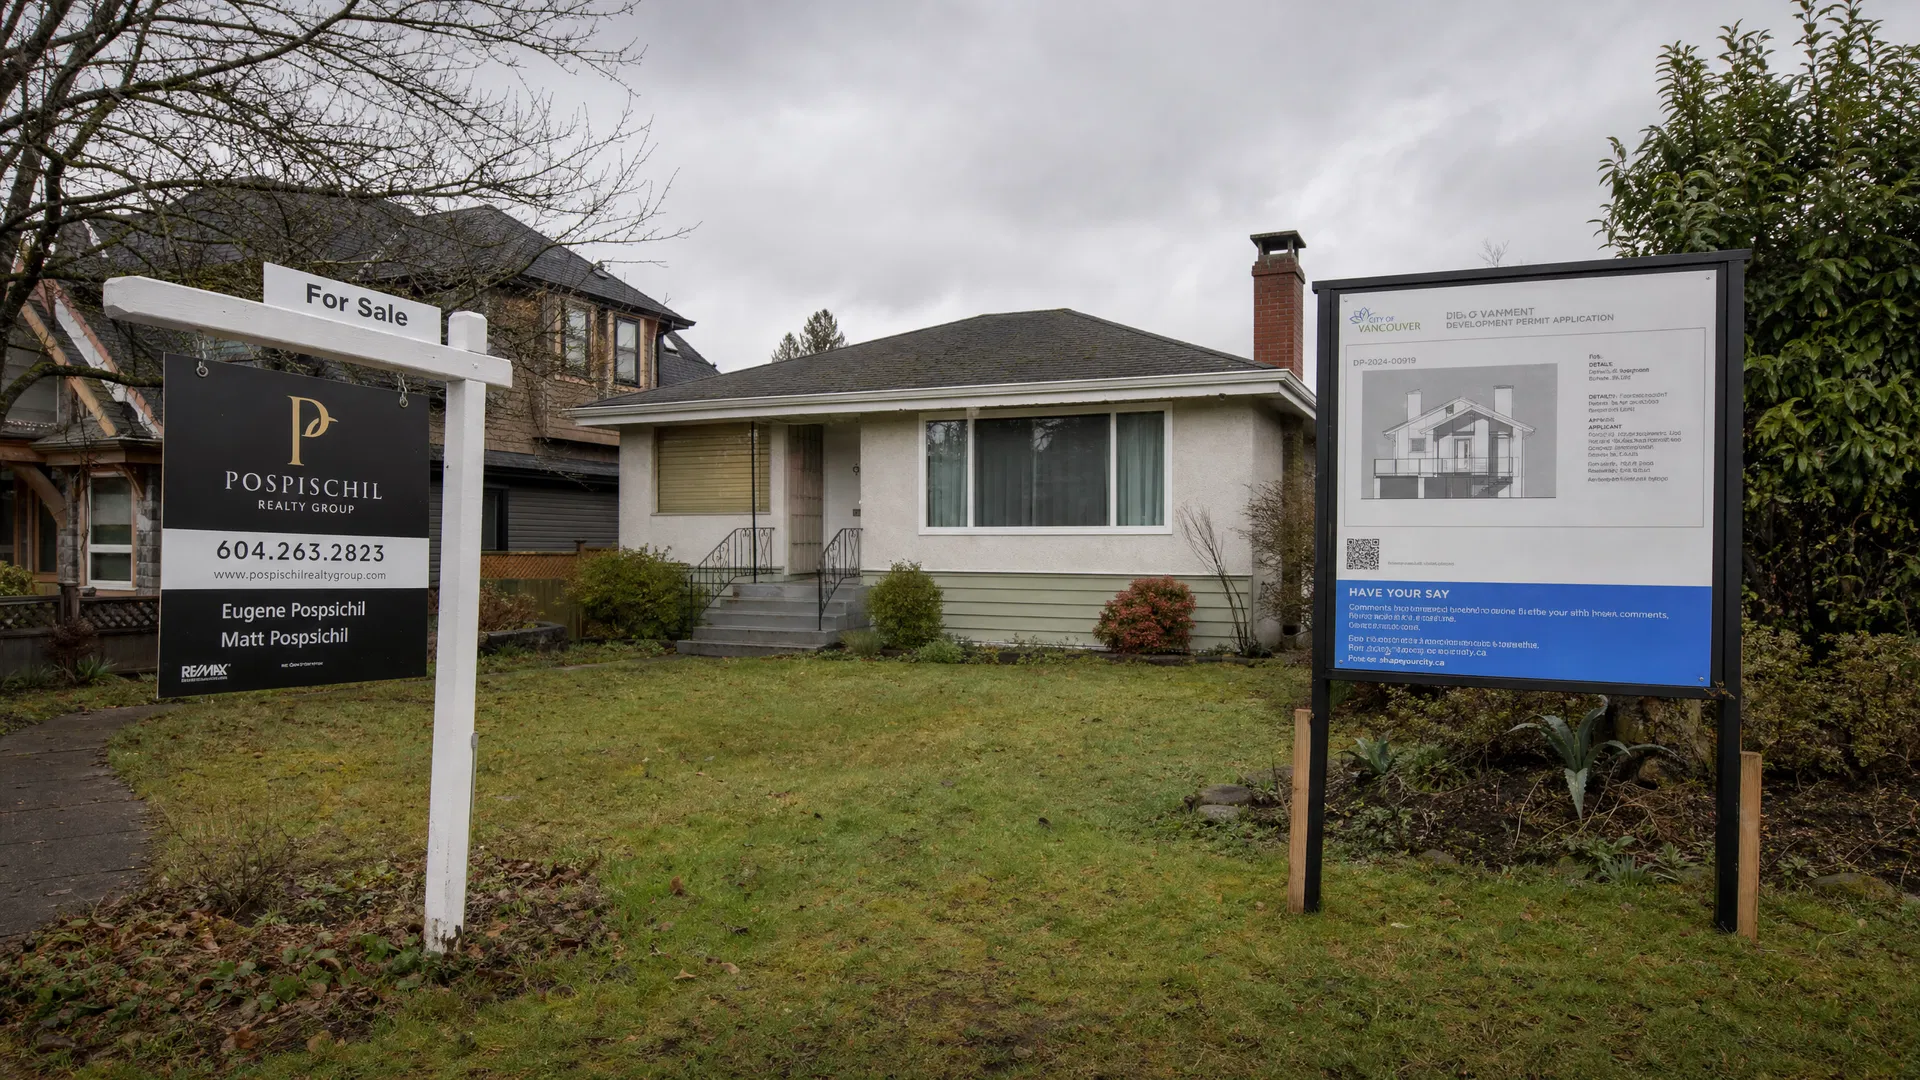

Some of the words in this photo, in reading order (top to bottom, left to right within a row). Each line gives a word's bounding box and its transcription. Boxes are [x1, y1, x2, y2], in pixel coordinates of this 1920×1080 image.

[305, 282, 349, 312] For
[357, 297, 408, 327] Sale
[1358, 321, 1421, 333] VANCOUVER
[1368, 316, 1384, 324] CITY
[1446, 319, 1513, 329] DEVELOPMENT
[1516, 316, 1550, 326] PERMIT
[1553, 313, 1614, 324] APPLICATION
[1353, 356, 1417, 367] DP-2024-00919
[225, 470, 383, 500] POSPISCHIL
[258, 499, 306, 512] REALTY
[311, 502, 355, 514] GROUP
[216, 540, 384, 562] 604.263.2823
[213, 569, 387, 582] www.pospischilrealtygroup.com
[1349, 587, 1382, 598] HAVE
[1386, 588, 1422, 599] YOUR
[1425, 589, 1450, 599] SAY
[222, 603, 286, 623] Eugene
[291, 600, 365, 621] Pospsichil
[1548, 608, 1568, 618] your
[1619, 610, 1669, 620] comments,
[221, 631, 265, 648] Matt
[270, 627, 348, 649] Pospsichil
[181, 663, 228, 678] RE/MAX
